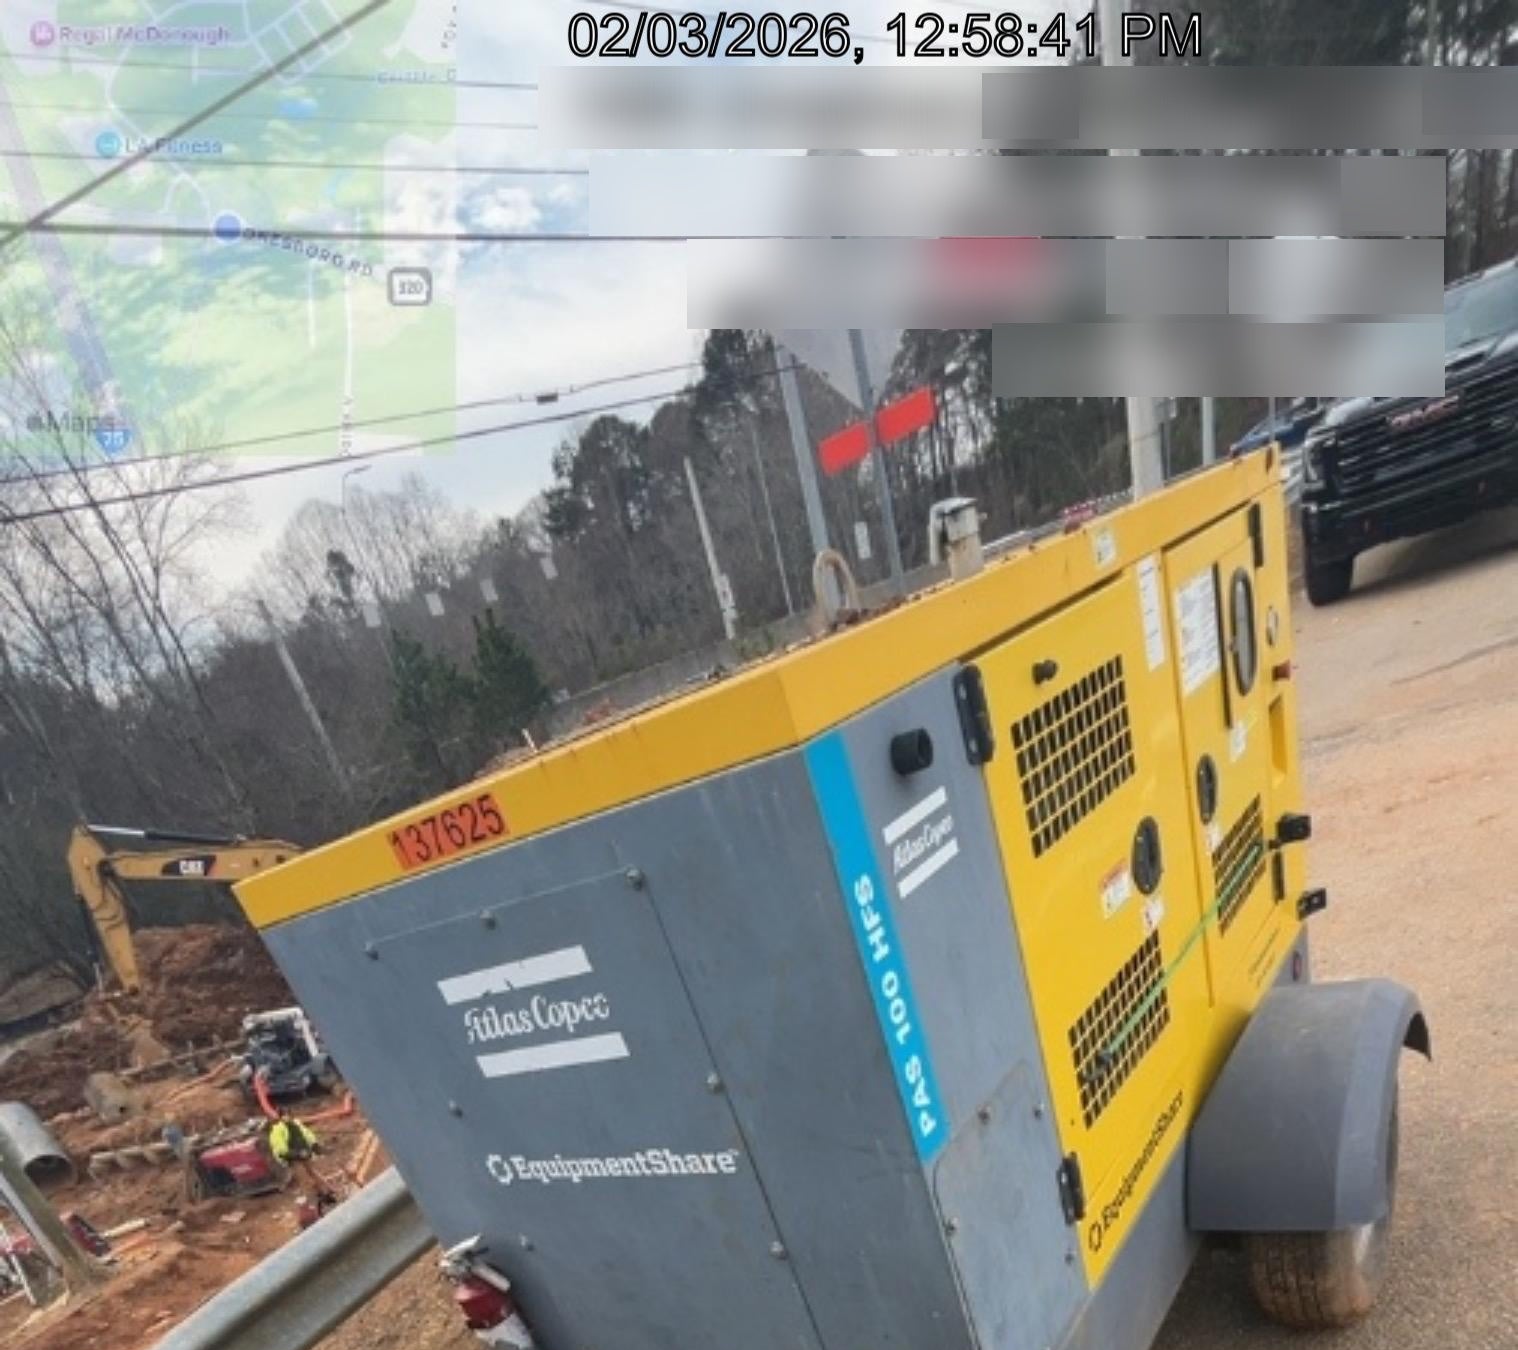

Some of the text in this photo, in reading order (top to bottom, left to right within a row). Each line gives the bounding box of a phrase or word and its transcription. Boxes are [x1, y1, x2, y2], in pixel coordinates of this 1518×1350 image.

[390, 793, 505, 867] 137625
[854, 873, 937, 1138] PAS 100 HFS
